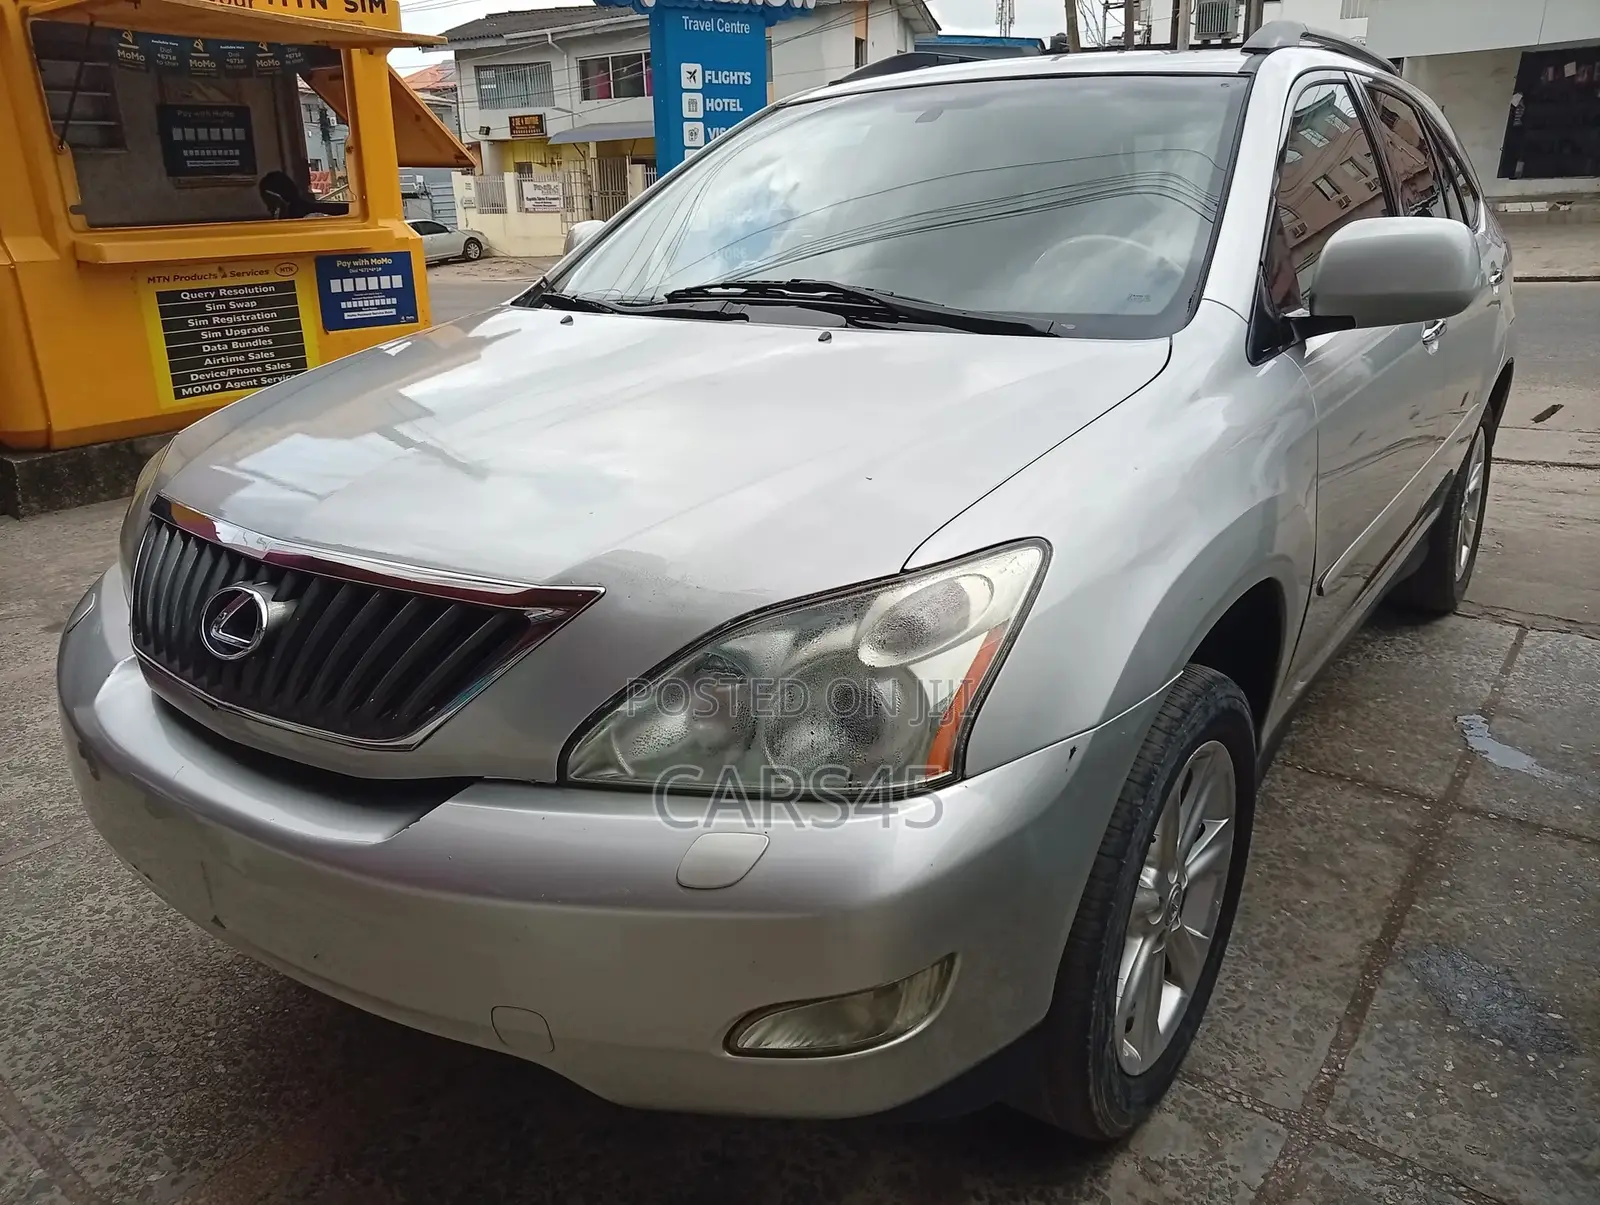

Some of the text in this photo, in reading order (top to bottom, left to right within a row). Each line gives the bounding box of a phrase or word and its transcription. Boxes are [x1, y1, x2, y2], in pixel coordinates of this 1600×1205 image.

[682, 15, 750, 34] Travel Centre
[117, 49, 145, 61] MoMo
[189, 59, 216, 68] MoMo
[255, 59, 281, 68] MoMo
[704, 70, 752, 85] FLIGHTS
[706, 98, 743, 112] HOTEL
[336, 257, 393, 268] Pay with MoMo
[147, 275, 170, 284] MTN
[173, 270, 218, 283] Products
[229, 268, 270, 278] Services
[180, 284, 276, 301] Query Resolution
[205, 299, 258, 312] Sim Swap
[187, 311, 278, 327] Sim Registration
[200, 324, 270, 340] Sim Upgrade
[202, 338, 273, 353] Data Bundles
[203, 350, 275, 366] Airtime Sales
[190, 361, 292, 382] Device/Phone Sales
[181, 382, 222, 397] MOMO
[225, 378, 258, 390] Agent
